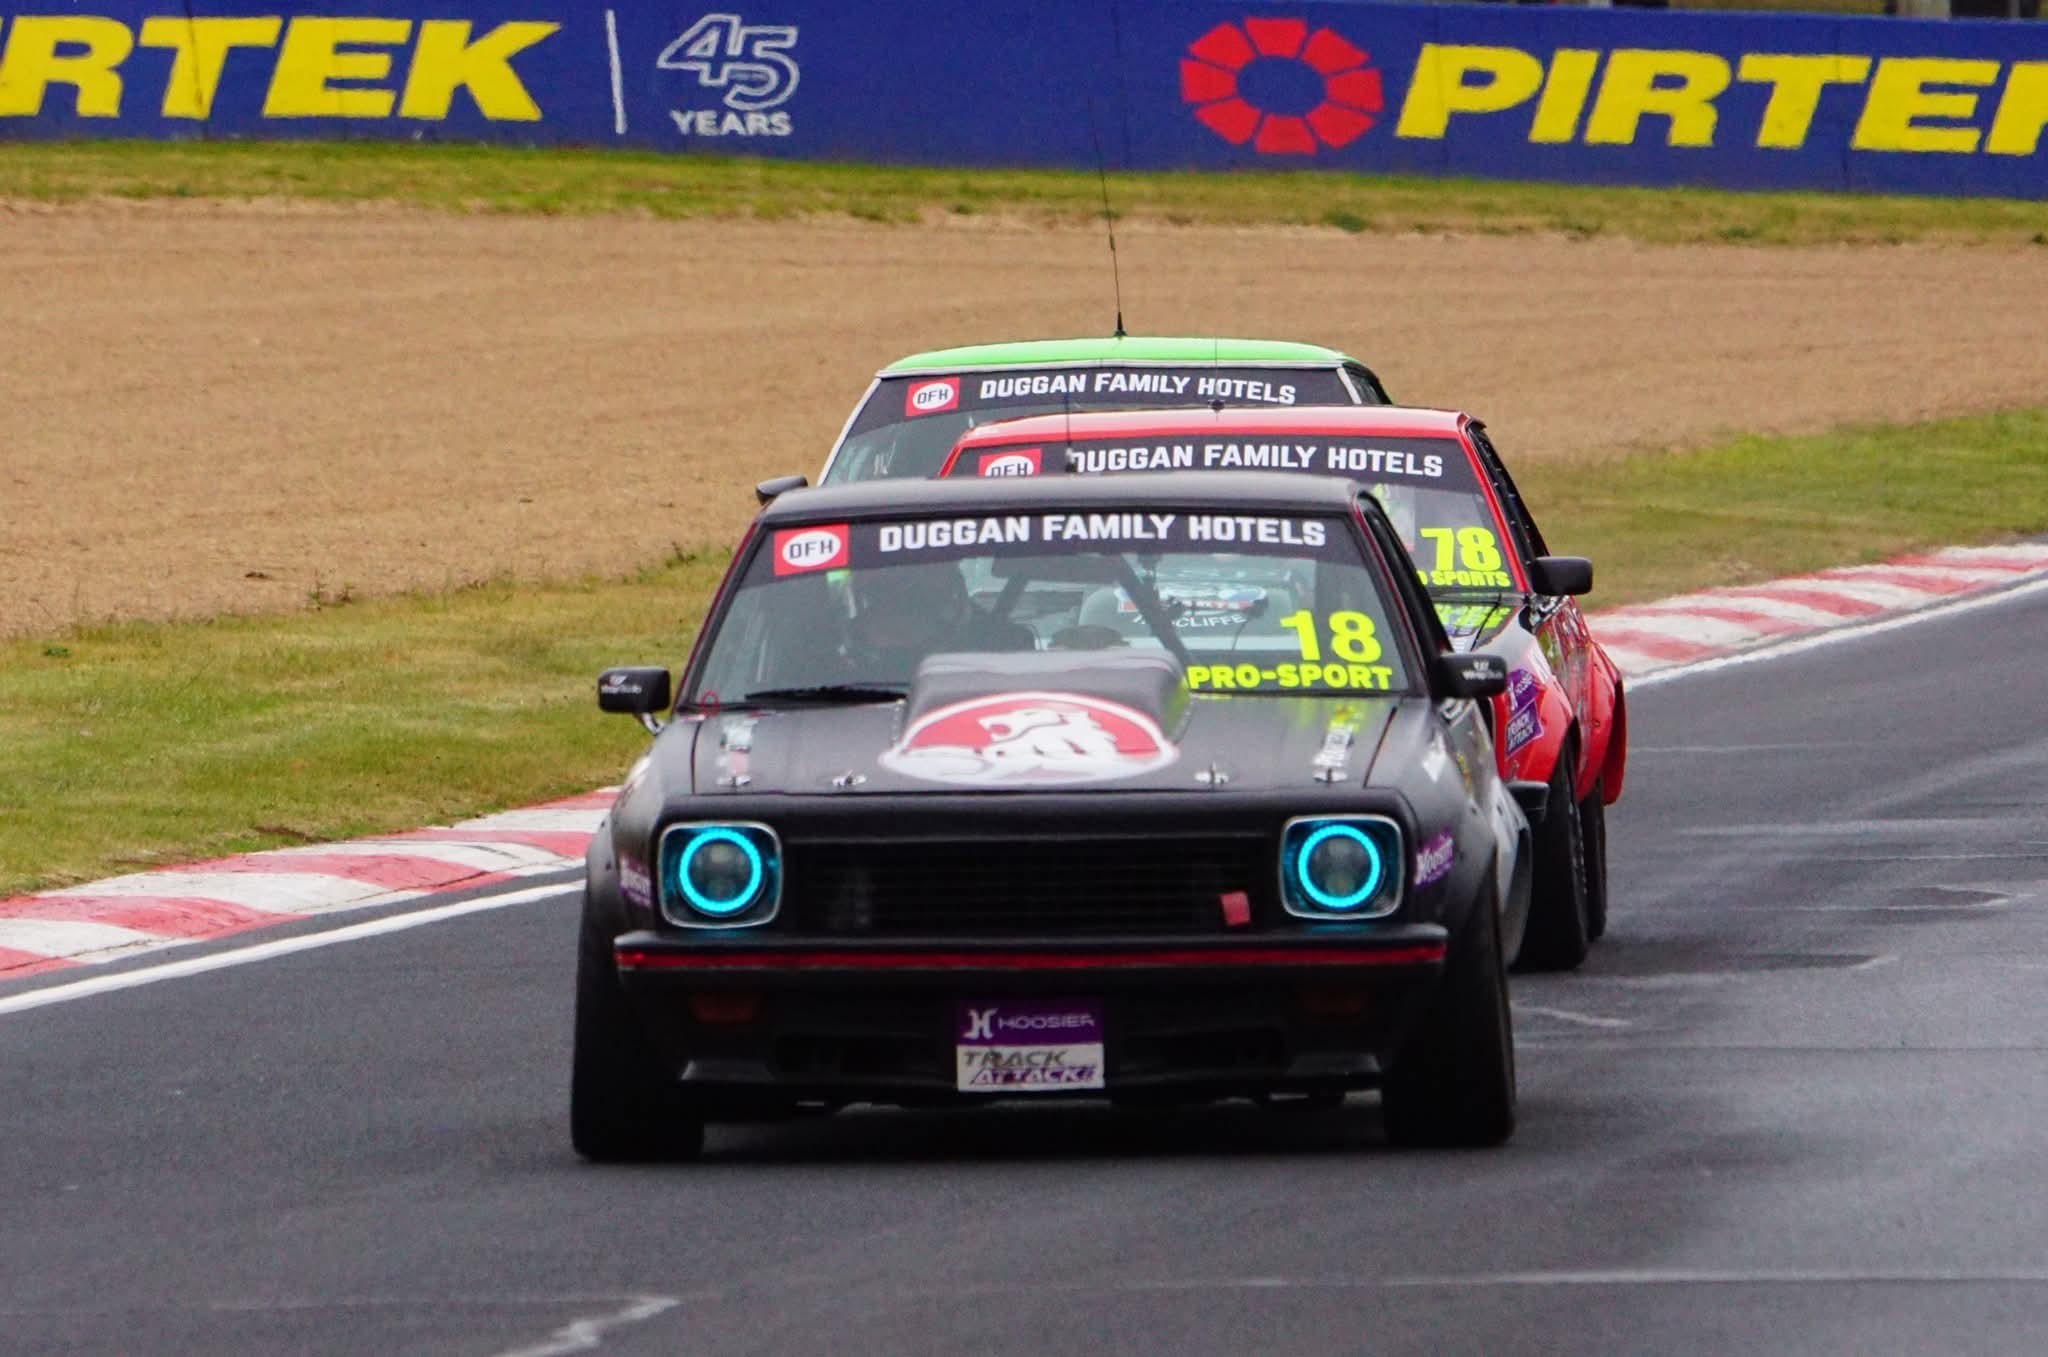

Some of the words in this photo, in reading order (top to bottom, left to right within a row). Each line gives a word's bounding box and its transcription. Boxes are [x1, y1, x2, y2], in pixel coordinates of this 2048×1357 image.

[0, 15, 562, 121] RTEK
[657, 13, 799, 110] 45
[670, 110, 793, 136] YEARS
[980, 374, 1086, 400] DUGGAN
[1094, 373, 1190, 394] FAMILY
[1198, 377, 1296, 405] HOTELS
[1203, 443, 1317, 468] FAMILY
[1327, 447, 1443, 477] HOTELS
[788, 536, 833, 560] DFH
[879, 519, 1030, 552] DUGGAN
[1042, 514, 1176, 541] FAMILY
[1188, 519, 1326, 547] HOTELS
[1420, 526, 1502, 572] 78
[1432, 570, 1511, 587] SPORTS
[1280, 610, 1382, 663] 18
[1187, 663, 1393, 690] PRO-SPORT
[998, 1014, 1095, 1029] HOOSIER
[964, 1050, 1068, 1067] TRACK
